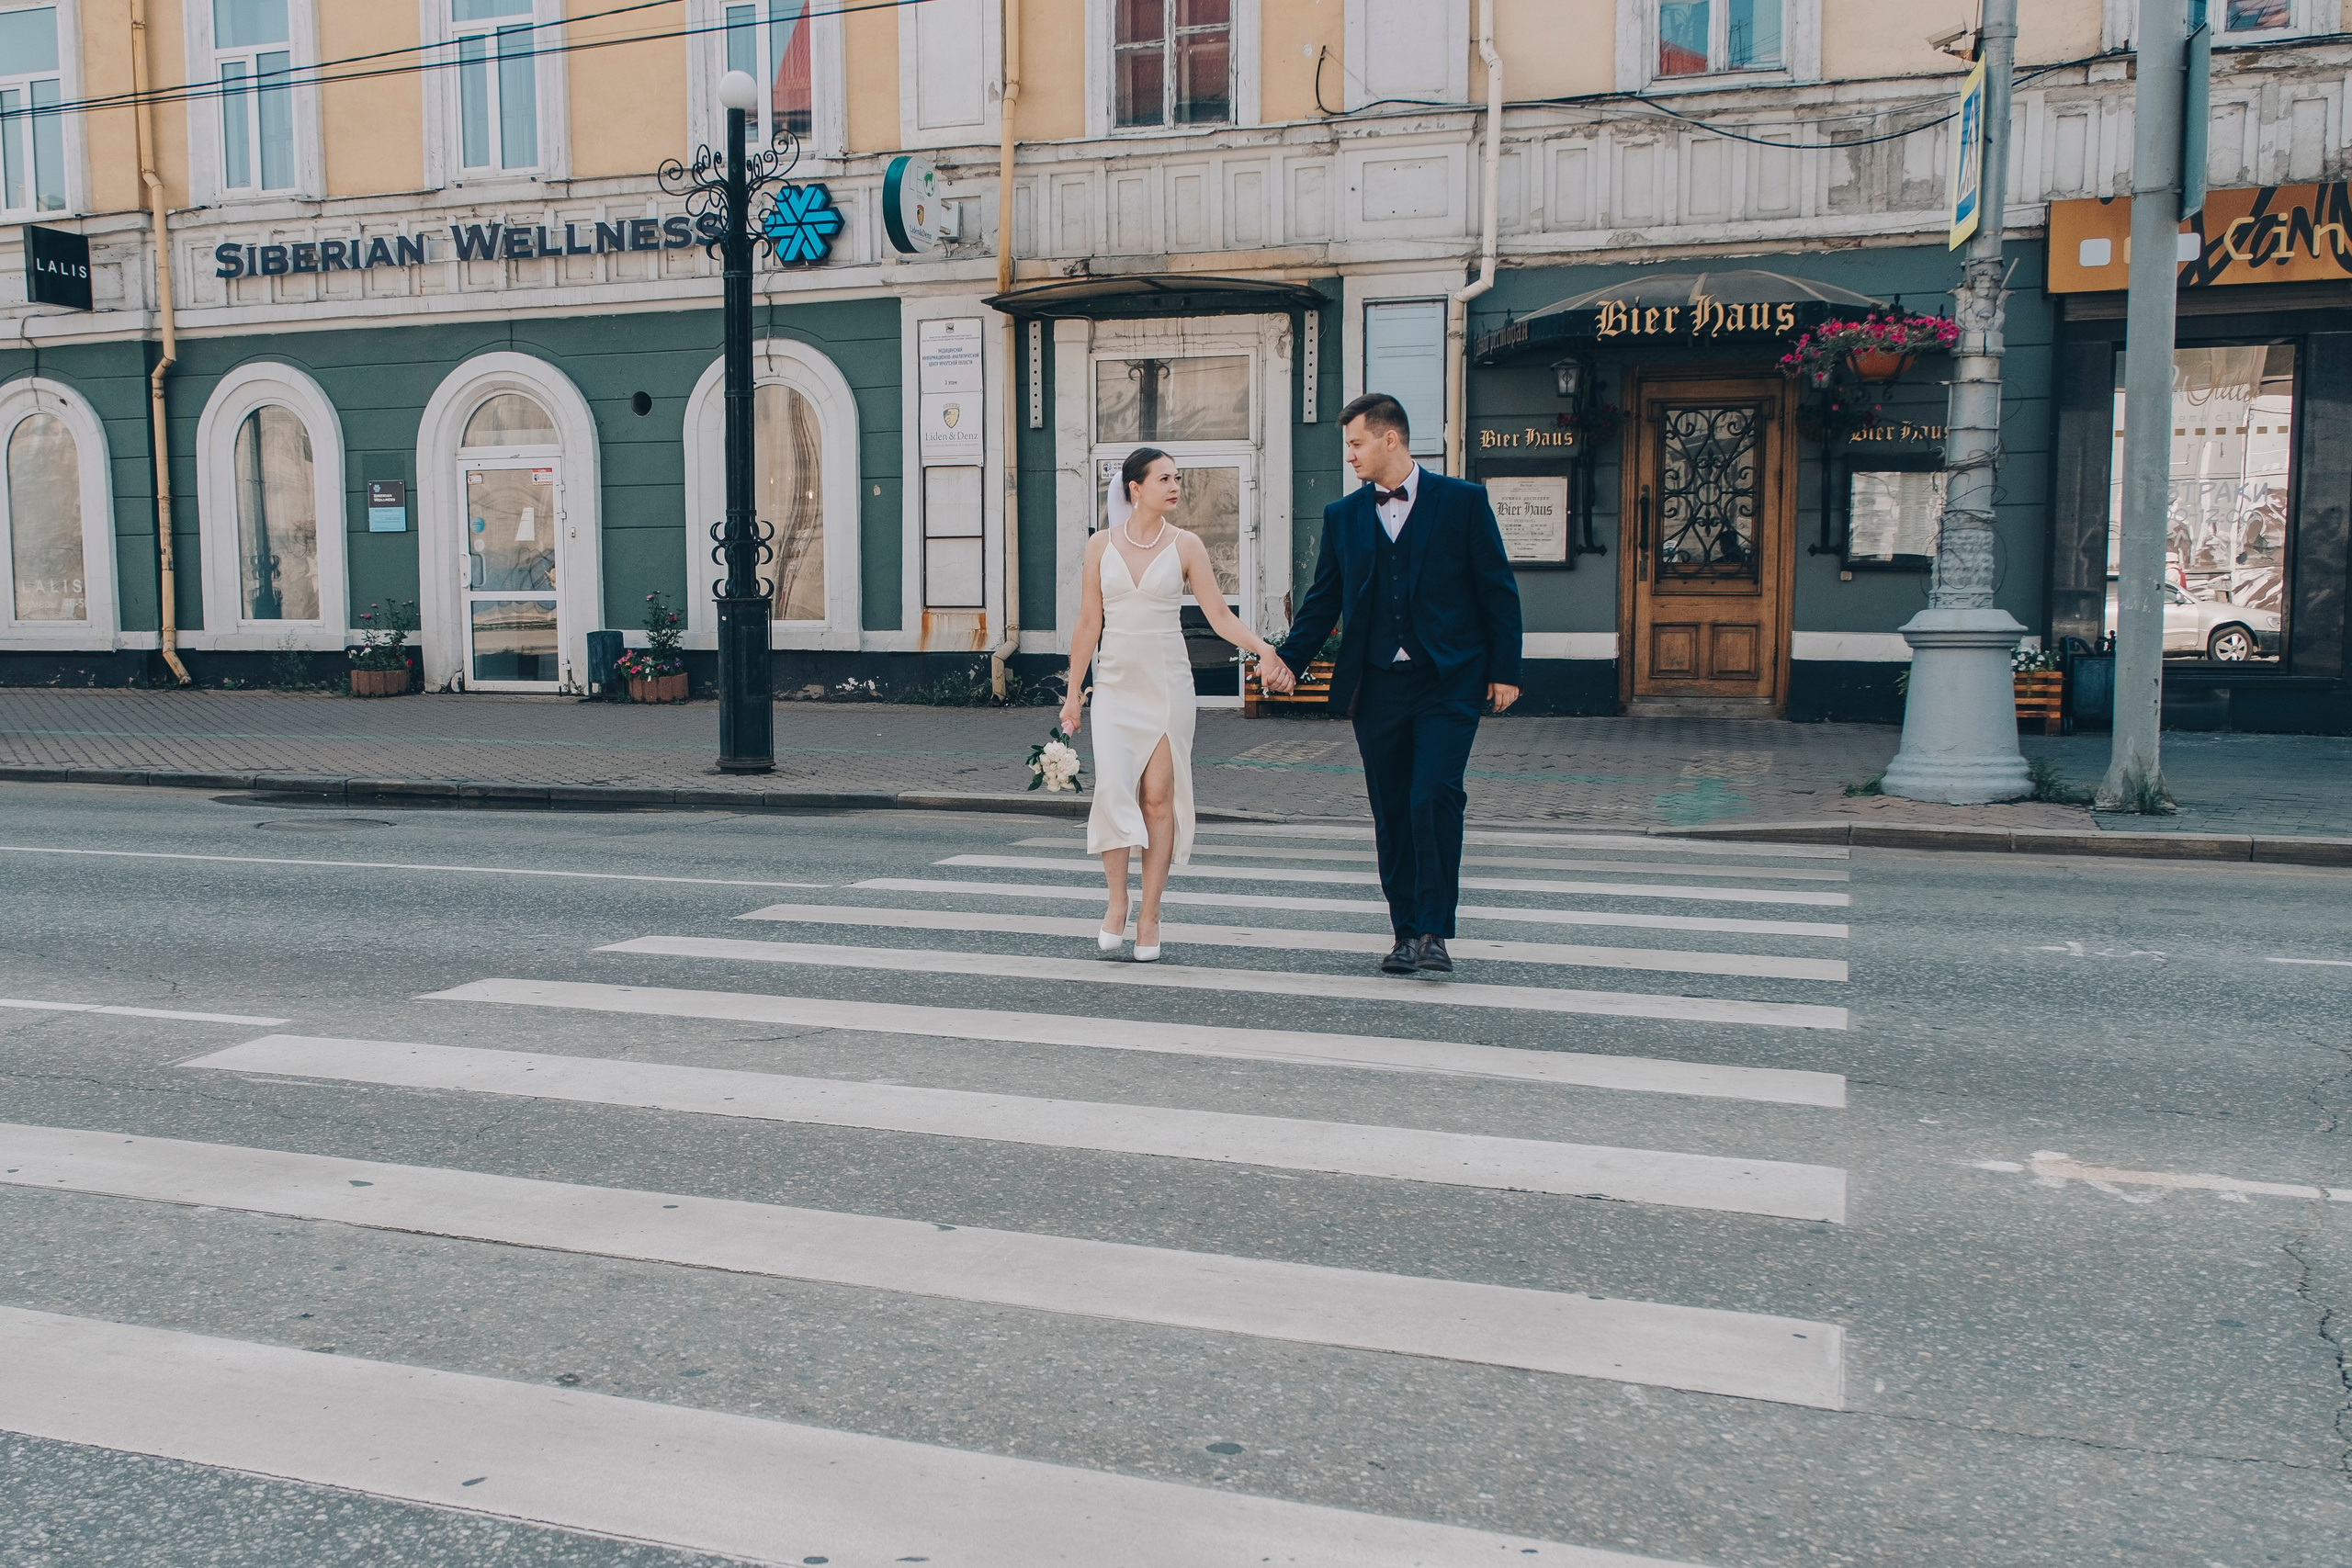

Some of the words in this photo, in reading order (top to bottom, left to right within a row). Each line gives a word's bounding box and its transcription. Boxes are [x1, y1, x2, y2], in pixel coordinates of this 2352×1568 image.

[215, 233, 429, 278] SIBERIAN
[449, 212, 724, 262] WELLNESS
[36, 257, 87, 279] LALIS
[1594, 295, 1680, 342] Bier
[1689, 293, 1796, 338] Haus
[925, 432, 947, 441] Liden
[949, 432, 956, 441] &
[956, 431, 978, 440] Denz
[1479, 429, 1521, 451] Bier
[1523, 427, 1574, 450] Haus
[1496, 501, 1522, 518] Bier
[1523, 502, 1554, 519] Haus
[22, 579, 83, 593] LALIS
